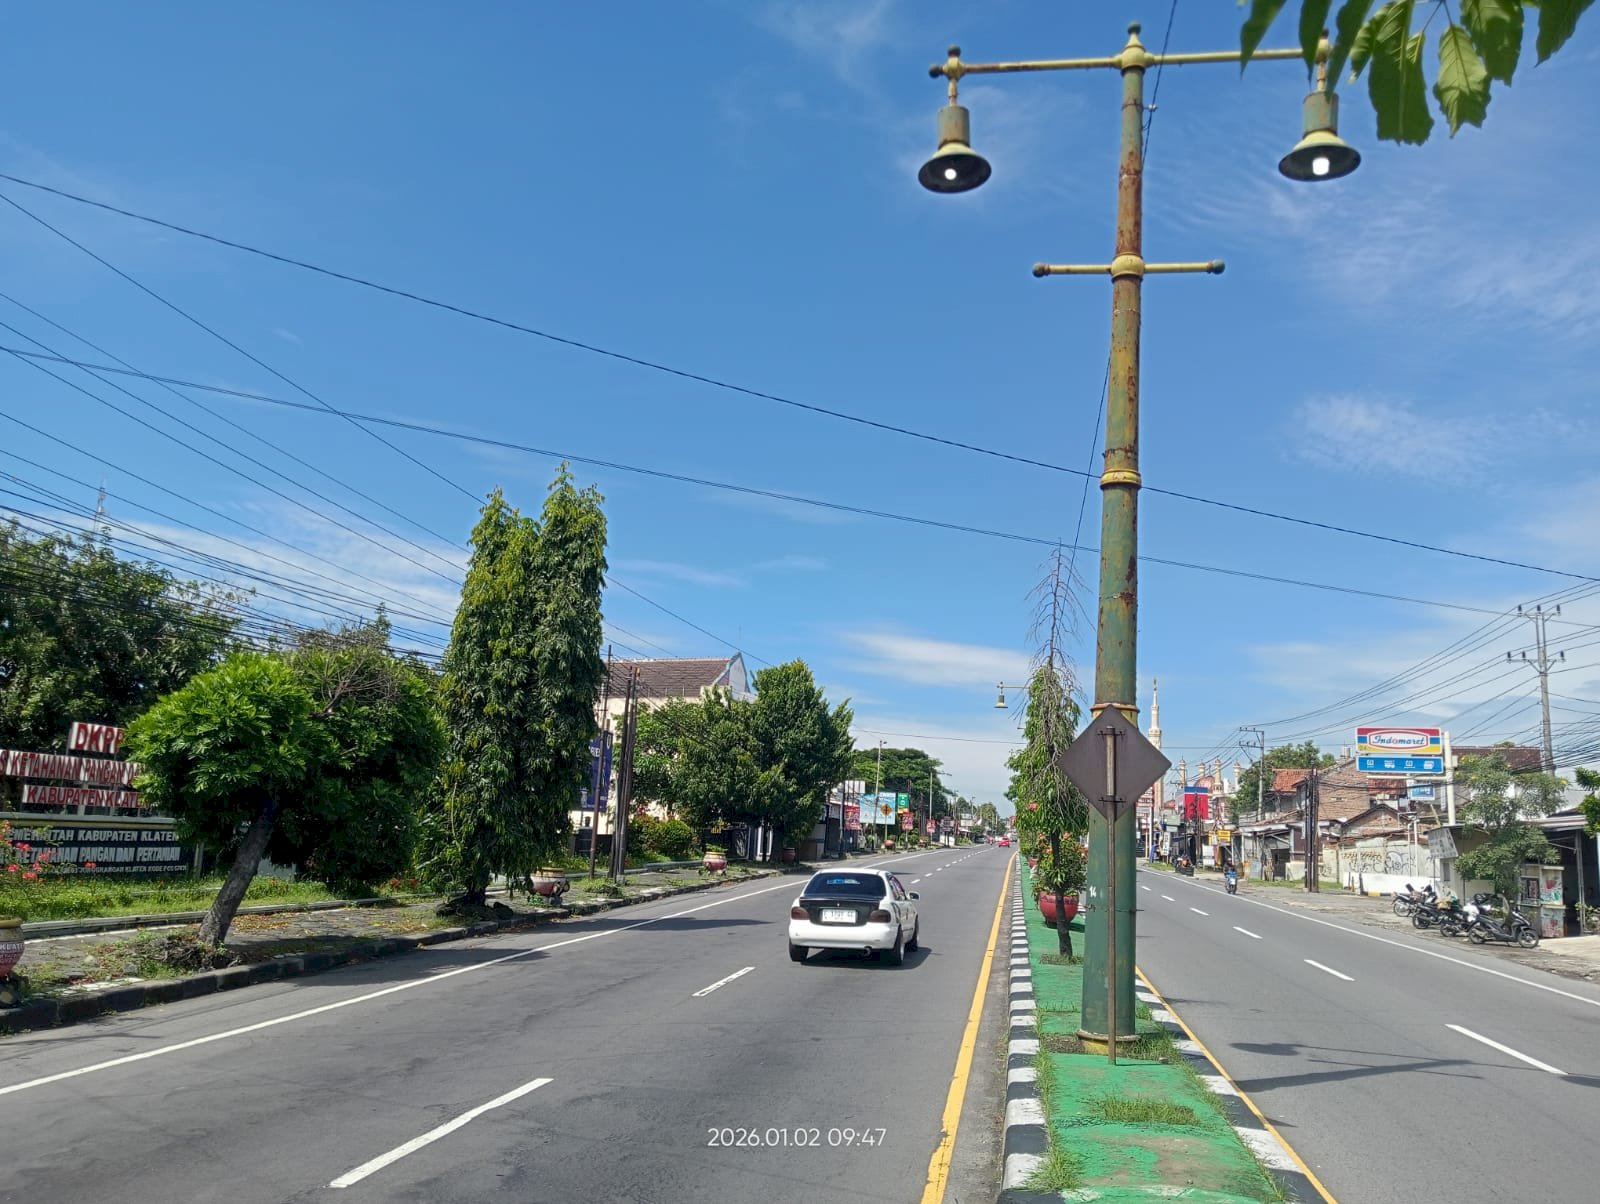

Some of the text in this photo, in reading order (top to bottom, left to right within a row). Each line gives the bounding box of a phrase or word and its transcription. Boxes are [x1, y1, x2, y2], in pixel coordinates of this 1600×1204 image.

[75, 723, 125, 753] DKPP
[1372, 735, 1425, 745] Indomaret
[11, 752, 82, 780] KETAHANAN
[84, 759, 125, 784] PANGAN
[27, 785, 104, 806] KABUPATEN
[78, 830, 138, 842] KABUPATEN
[79, 847, 115, 863] PANGAN
[115, 848, 135, 862] DAN
[136, 847, 181, 862] PERTANIAN
